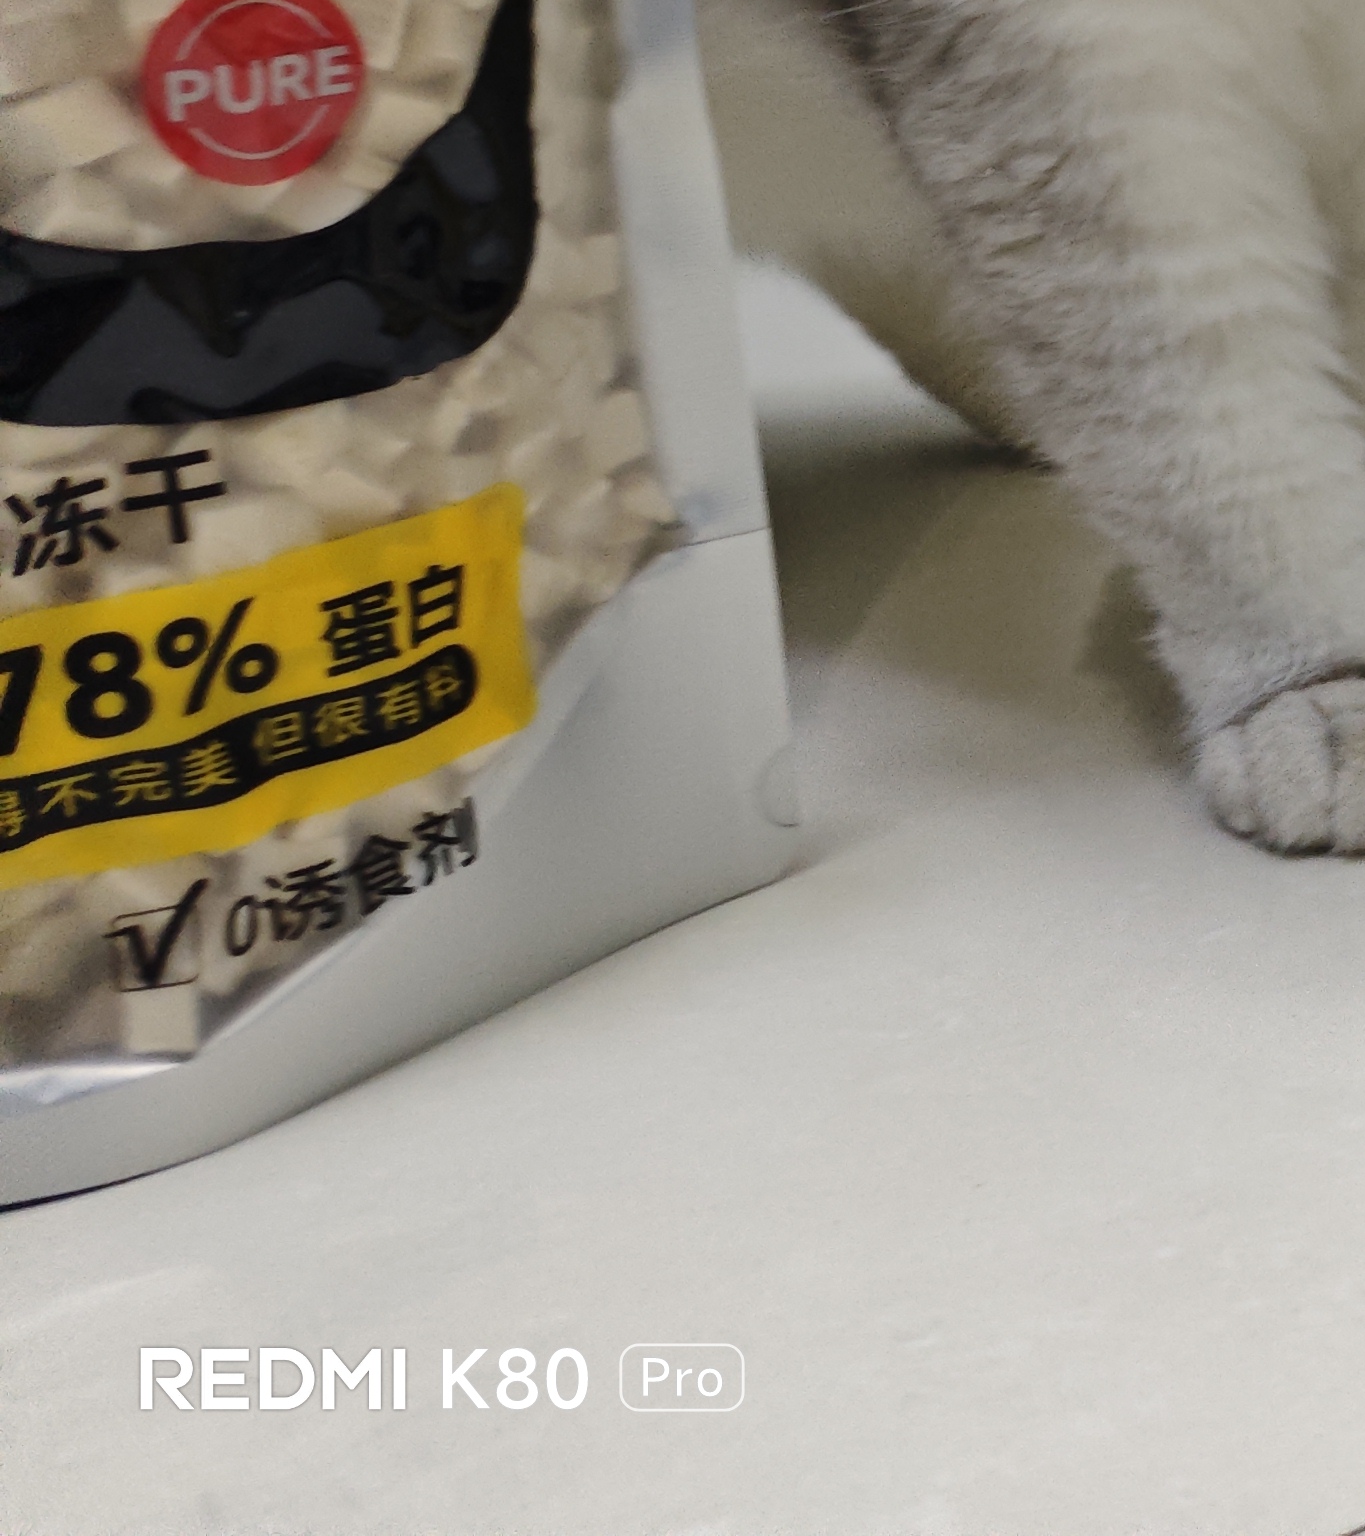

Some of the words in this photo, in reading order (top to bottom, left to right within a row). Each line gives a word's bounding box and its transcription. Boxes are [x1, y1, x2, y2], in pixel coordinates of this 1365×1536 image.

[164, 45, 357, 123] PURE
[3, 450, 226, 576] 冻干
[0, 597, 280, 756] 78%
[319, 563, 466, 677] 蛋白
